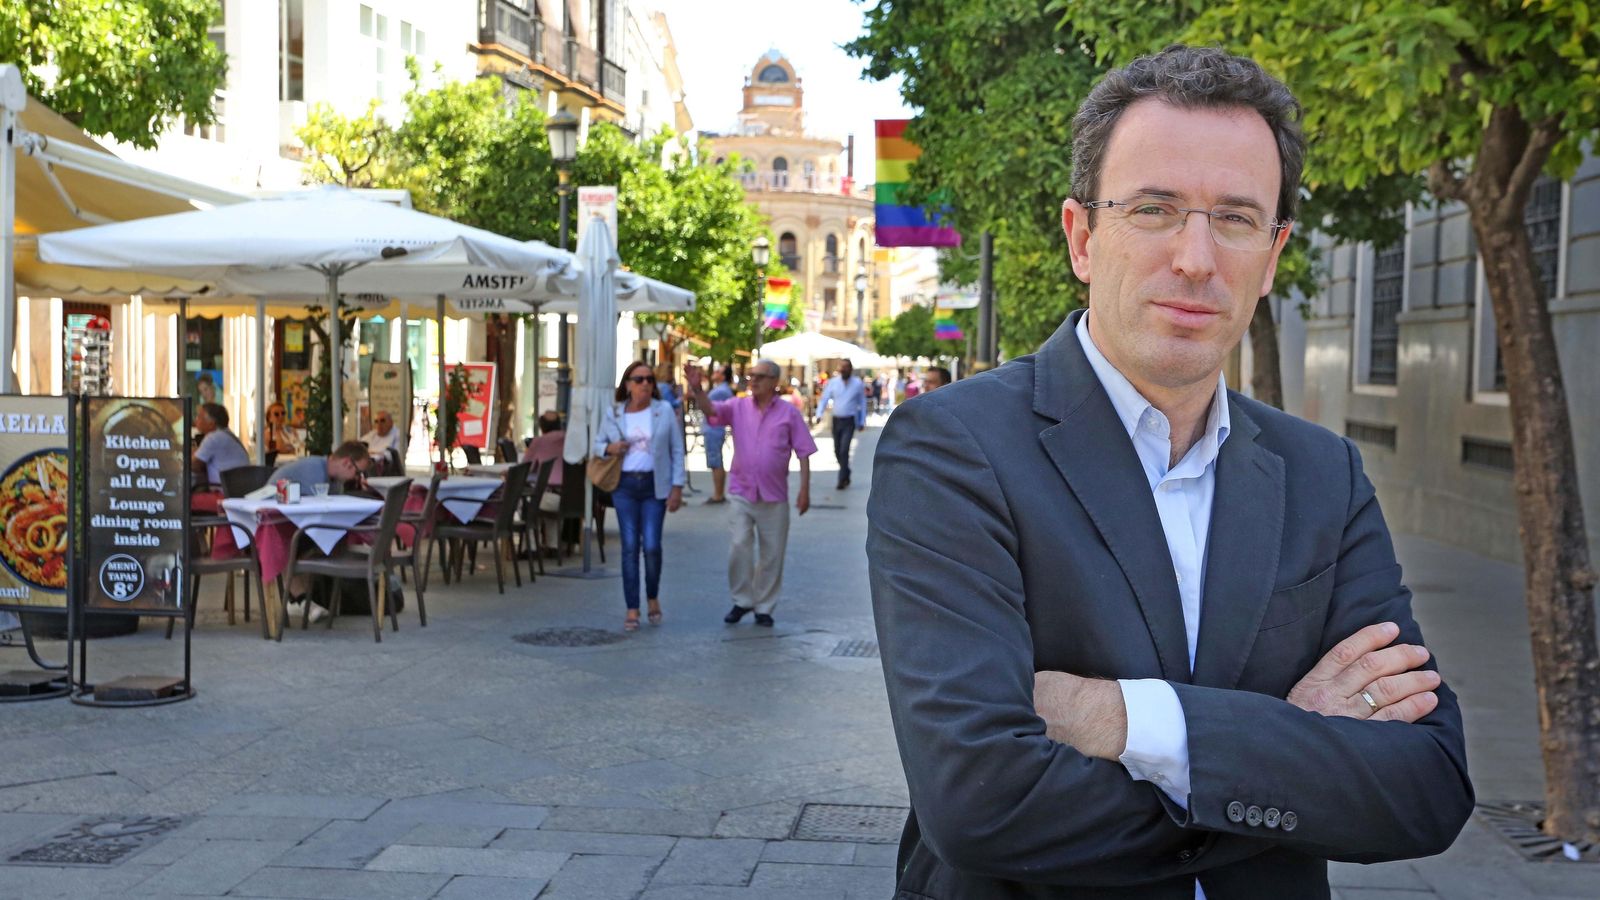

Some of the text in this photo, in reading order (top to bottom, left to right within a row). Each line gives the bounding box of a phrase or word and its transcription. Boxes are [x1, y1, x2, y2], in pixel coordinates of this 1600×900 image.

[105, 435, 170, 450] Kitchen
[116, 454, 160, 472] Open
[110, 474, 166, 492] all day
[109, 497, 165, 514] Lounge
[91, 514, 182, 531] dining room
[114, 533, 160, 547] inside
[107, 562, 137, 571] MENU
[107, 572, 138, 581] TAPAS
